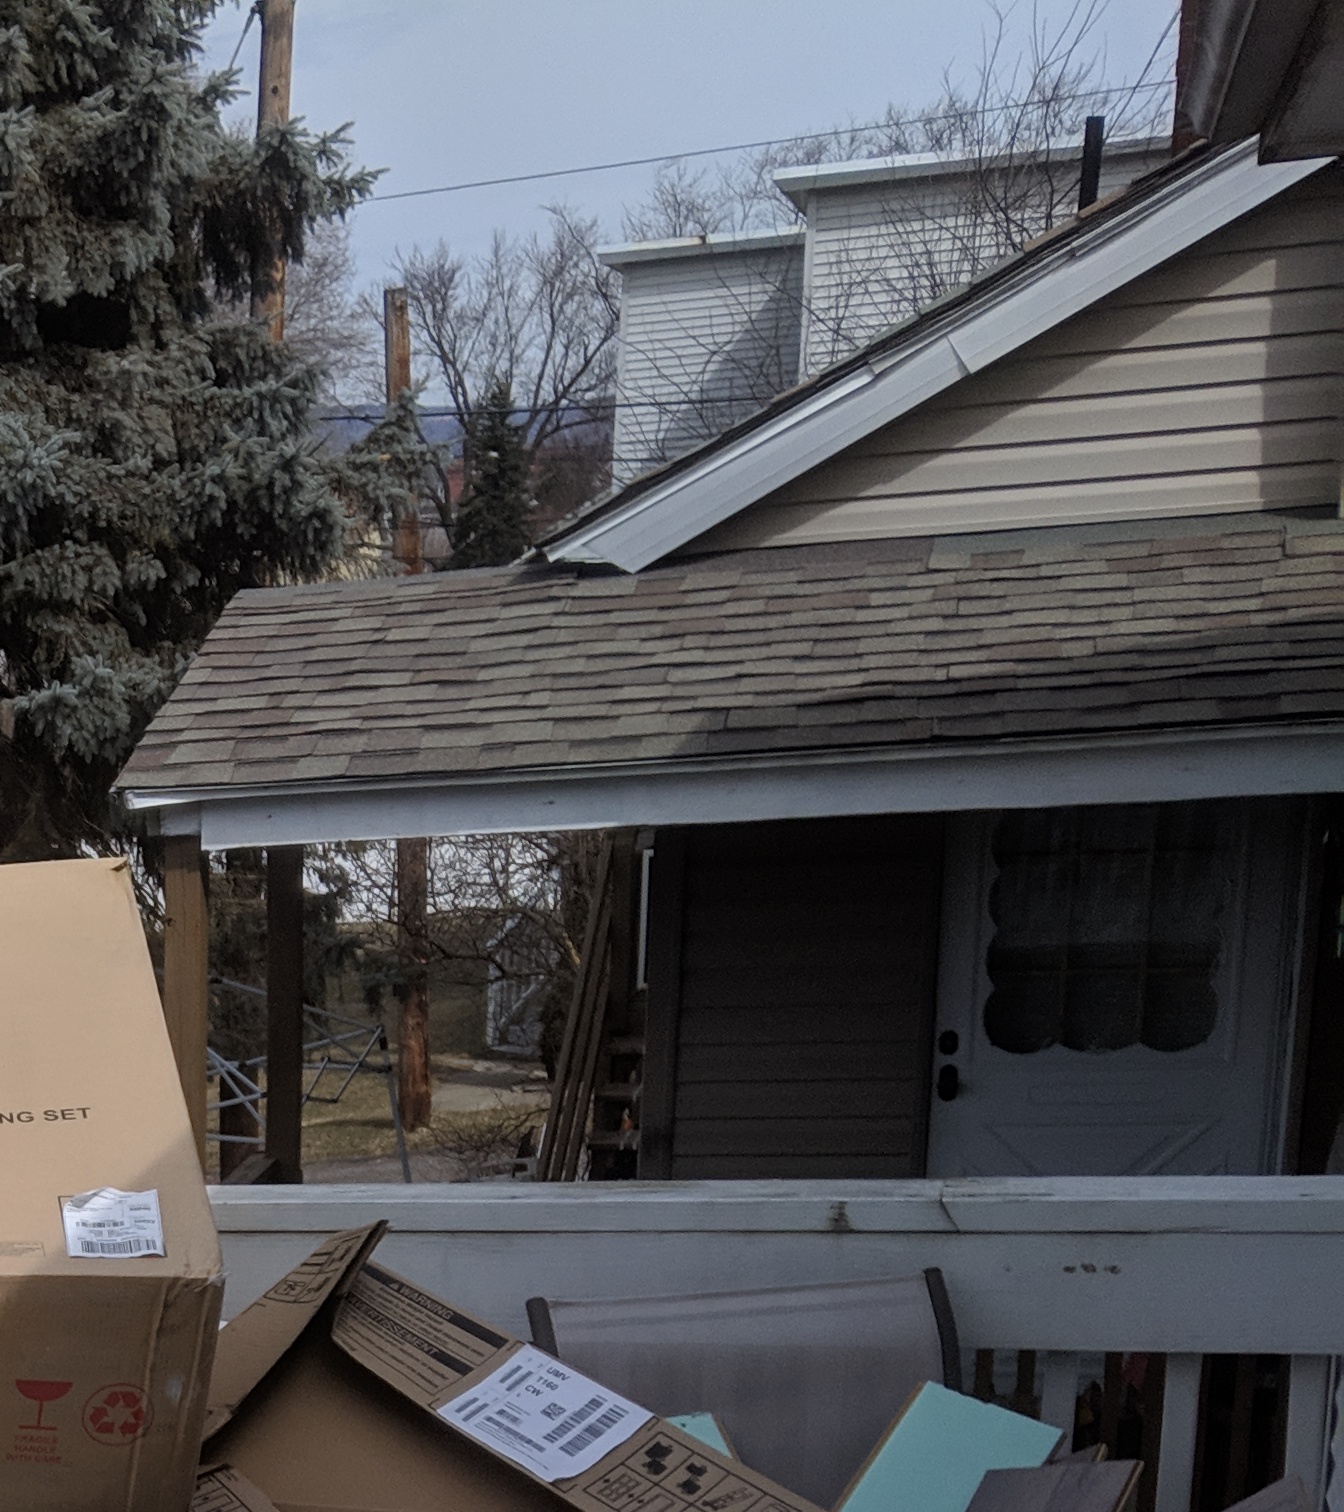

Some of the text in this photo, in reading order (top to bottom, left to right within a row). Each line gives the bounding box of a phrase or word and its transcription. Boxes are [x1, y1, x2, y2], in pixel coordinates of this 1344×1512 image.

[42, 1106, 91, 1122] SET
[398, 1283, 456, 1321] WARNING
[546, 1366, 571, 1382] UMV
[524, 1384, 544, 1397] CW
